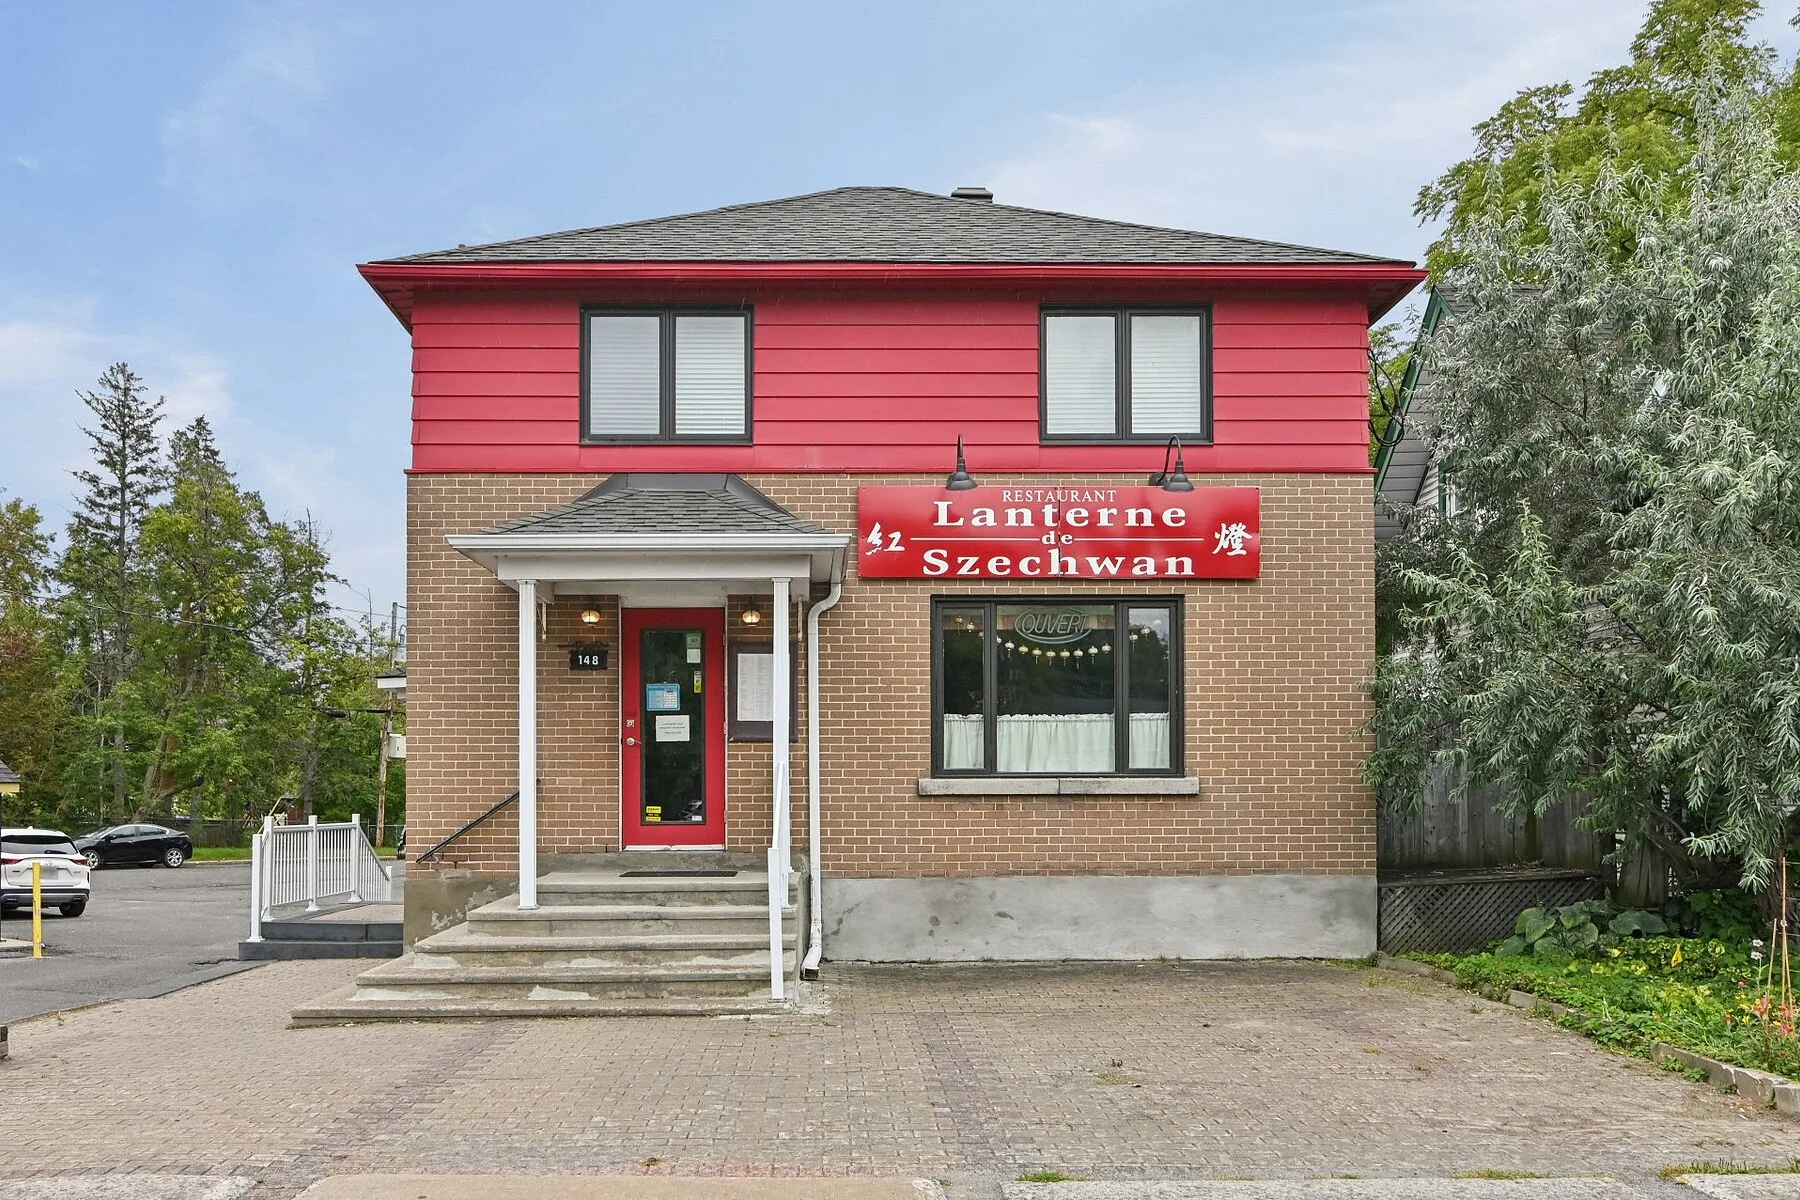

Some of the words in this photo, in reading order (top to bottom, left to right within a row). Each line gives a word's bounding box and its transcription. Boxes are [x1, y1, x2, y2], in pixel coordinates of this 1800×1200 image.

[1002, 489, 1117, 503] RESTAURANT
[933, 500, 1186, 527] Lanterne
[1041, 530, 1074, 546] de
[922, 548, 1195, 577] Szechwan
[1022, 613, 1088, 633] OUVERT
[578, 655, 599, 665] 148
